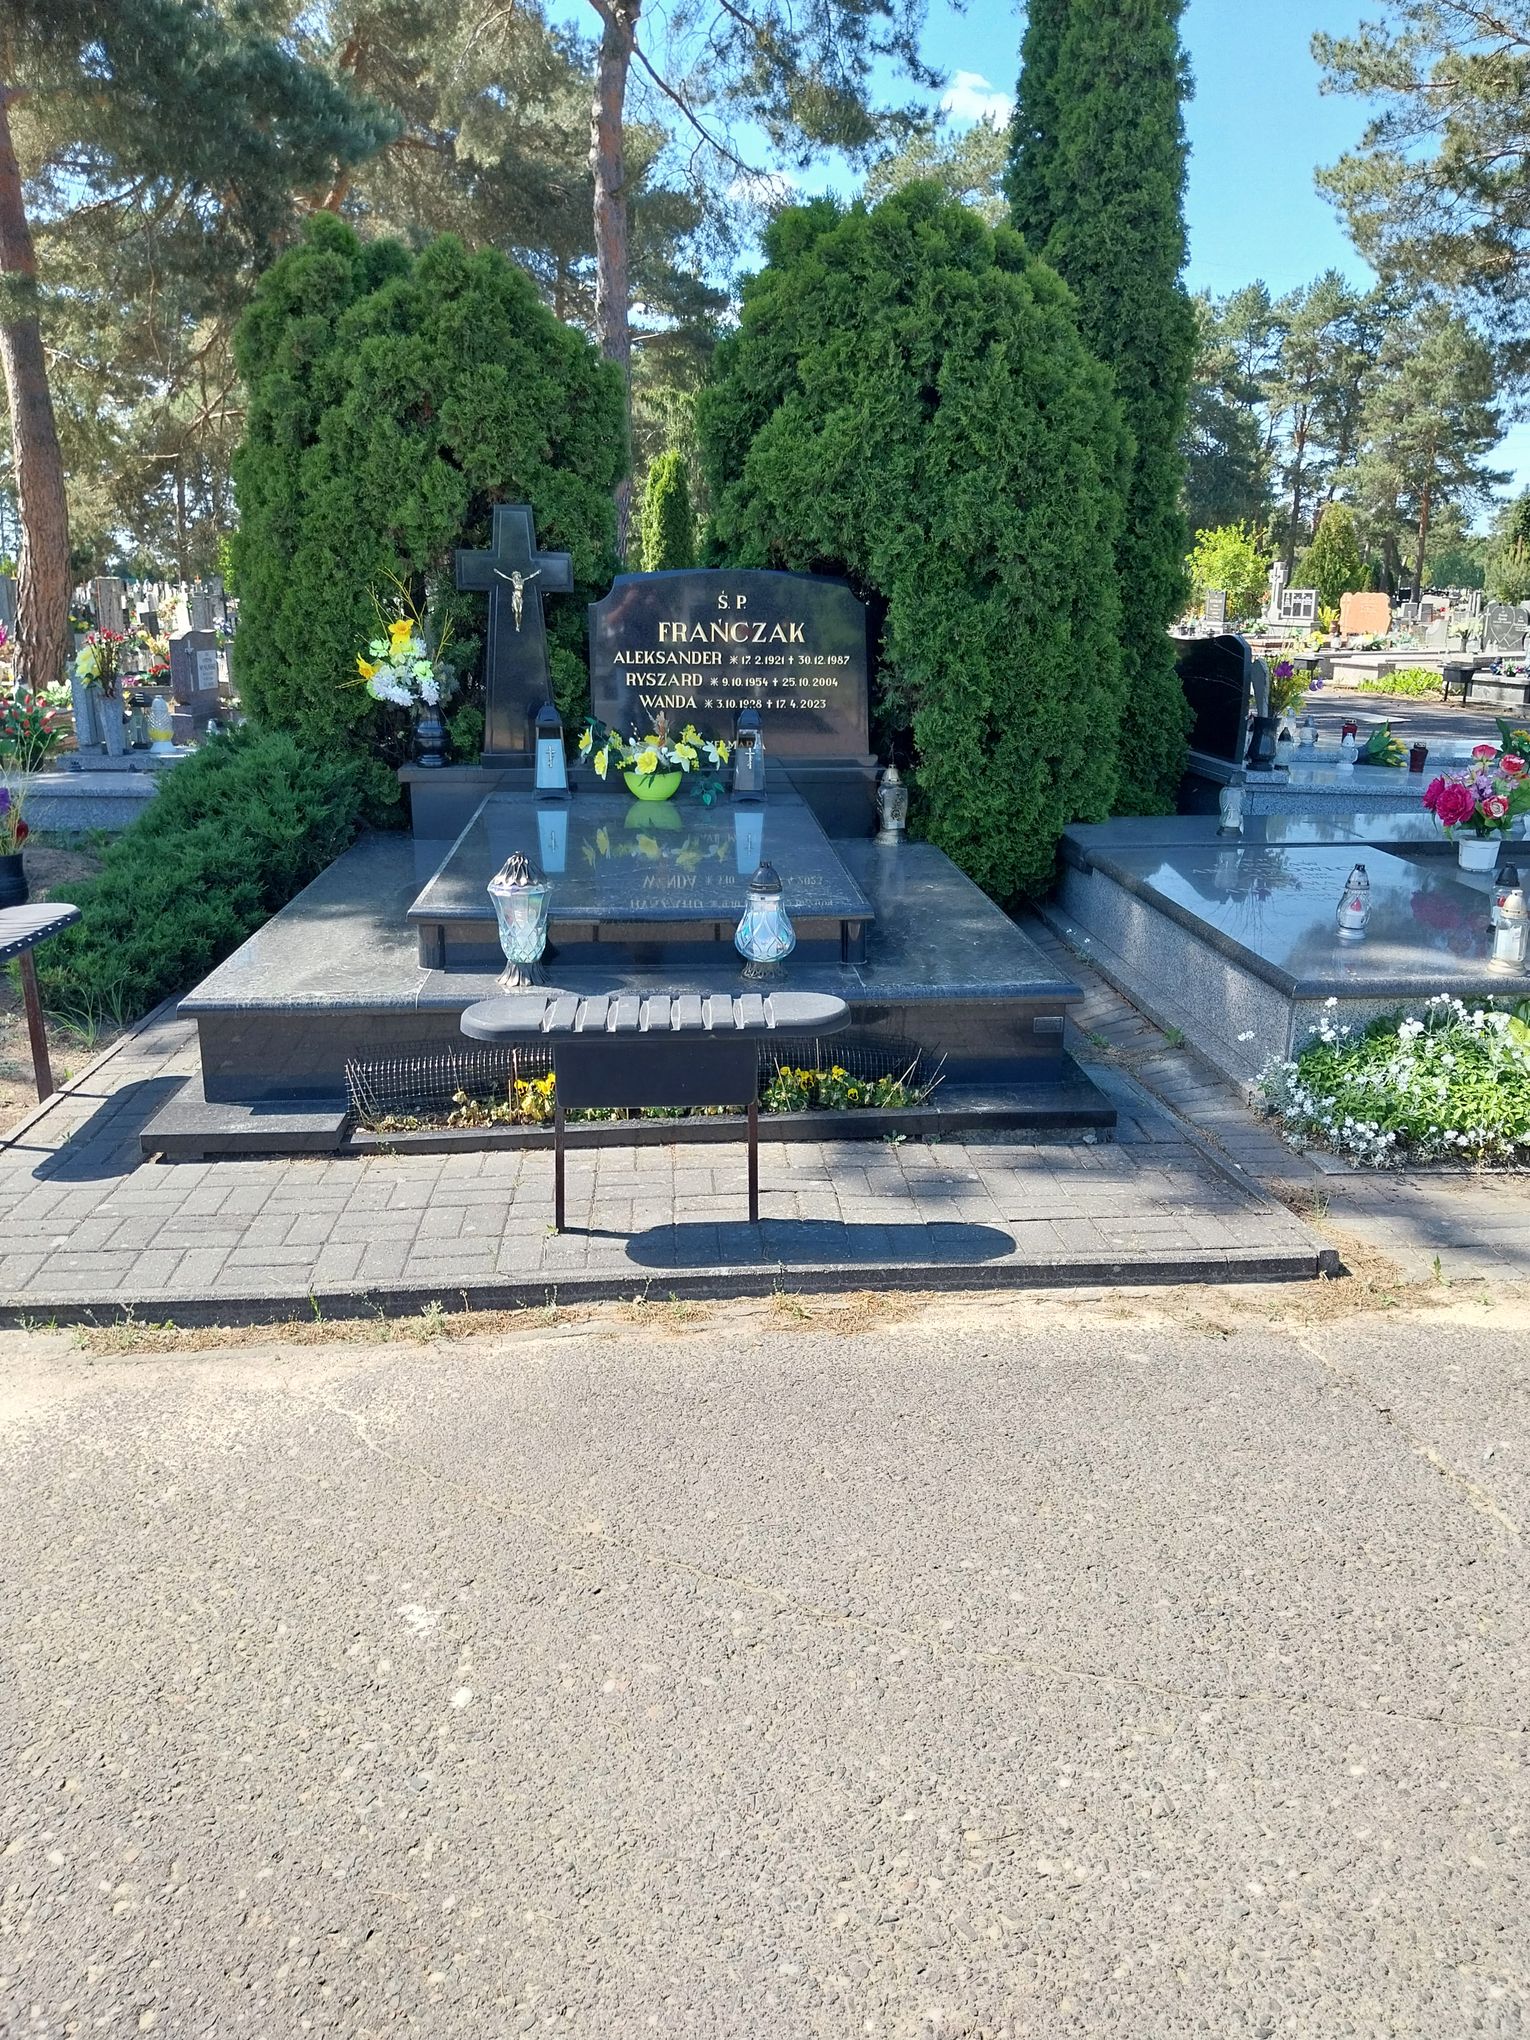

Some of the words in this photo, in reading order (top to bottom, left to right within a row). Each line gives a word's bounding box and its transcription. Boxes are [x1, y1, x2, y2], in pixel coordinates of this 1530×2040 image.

[658, 618, 806, 644] FRAŃCZAK
[613, 650, 723, 665] ALEKSANDER
[625, 672, 703, 687] RYSZARD
[639, 694, 698, 709] WANDA
